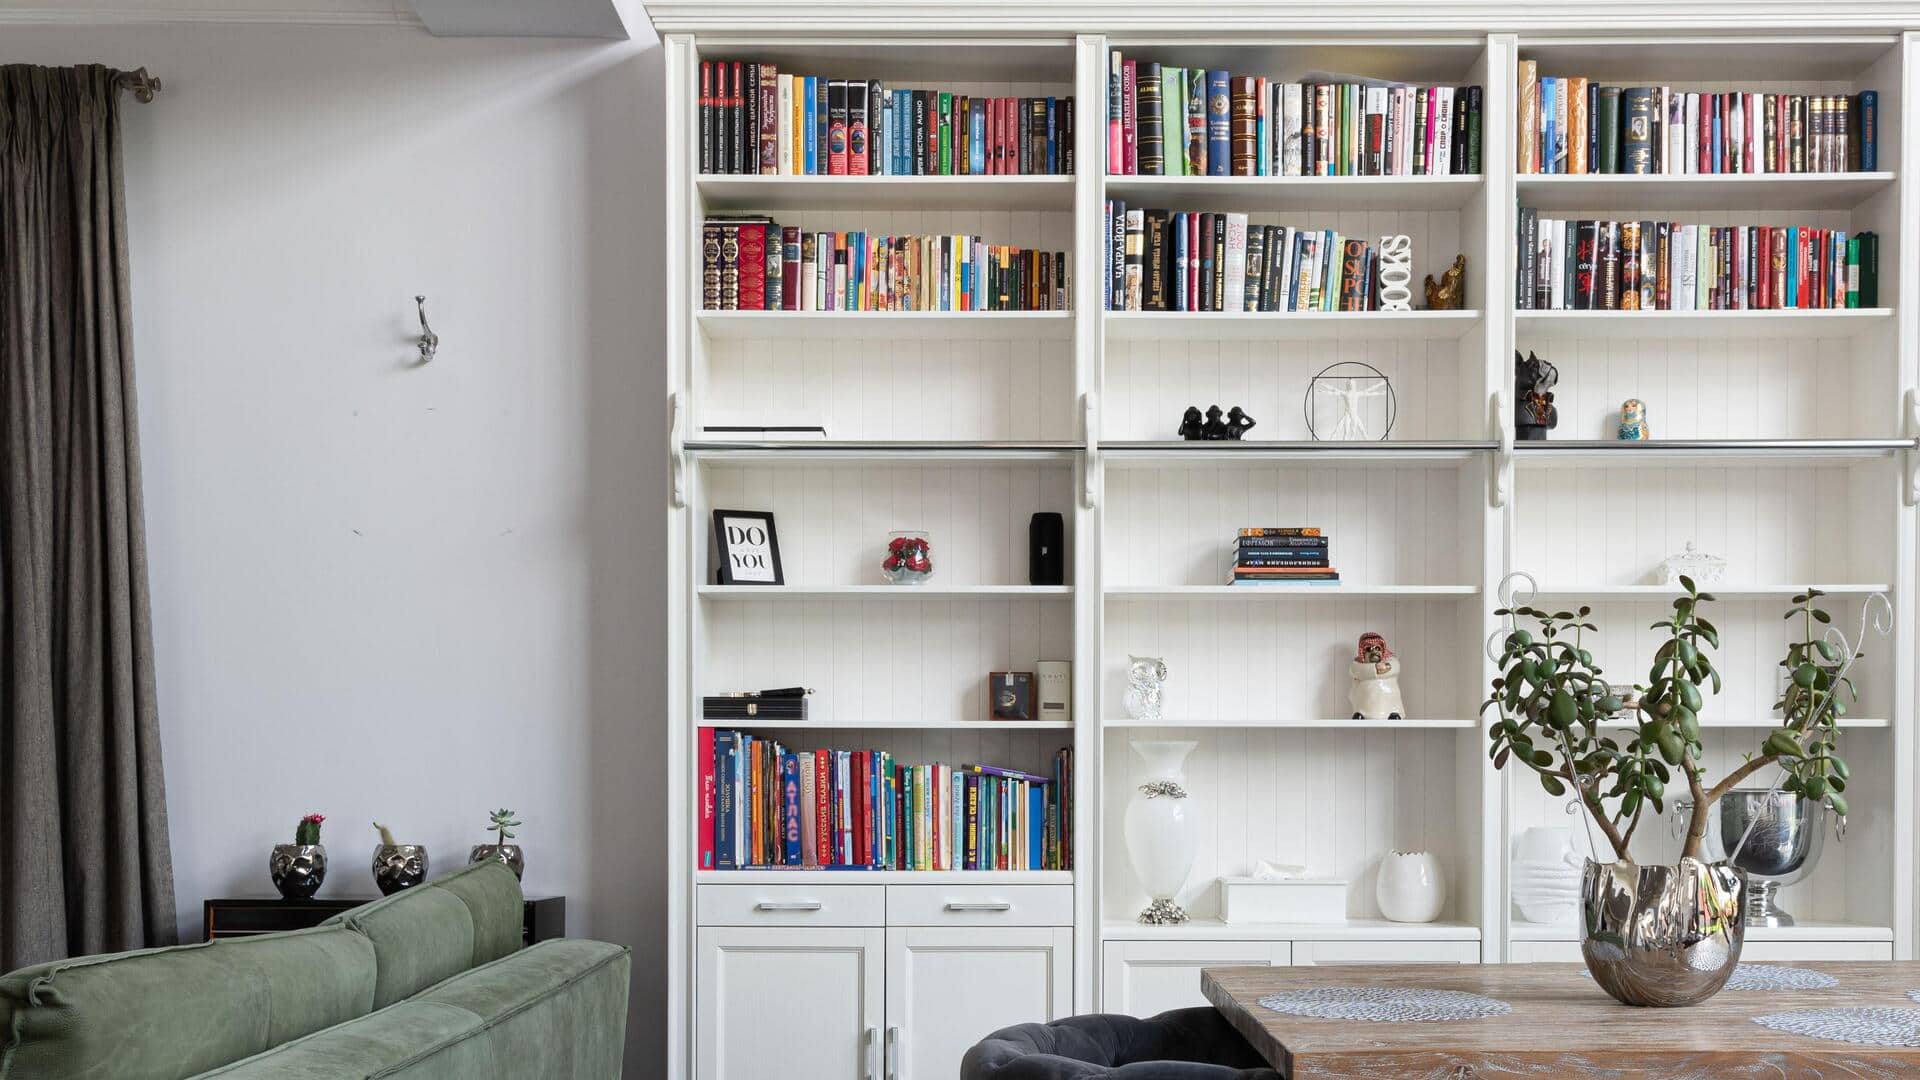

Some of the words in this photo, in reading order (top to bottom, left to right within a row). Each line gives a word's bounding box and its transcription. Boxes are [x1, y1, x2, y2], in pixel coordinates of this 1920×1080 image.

[1114, 214, 1124, 279] ЧАКРА-ЙОГА
[1380, 235, 1411, 311] BOOKS
[727, 526, 766, 546] DO
[731, 553, 768, 569] YOU
